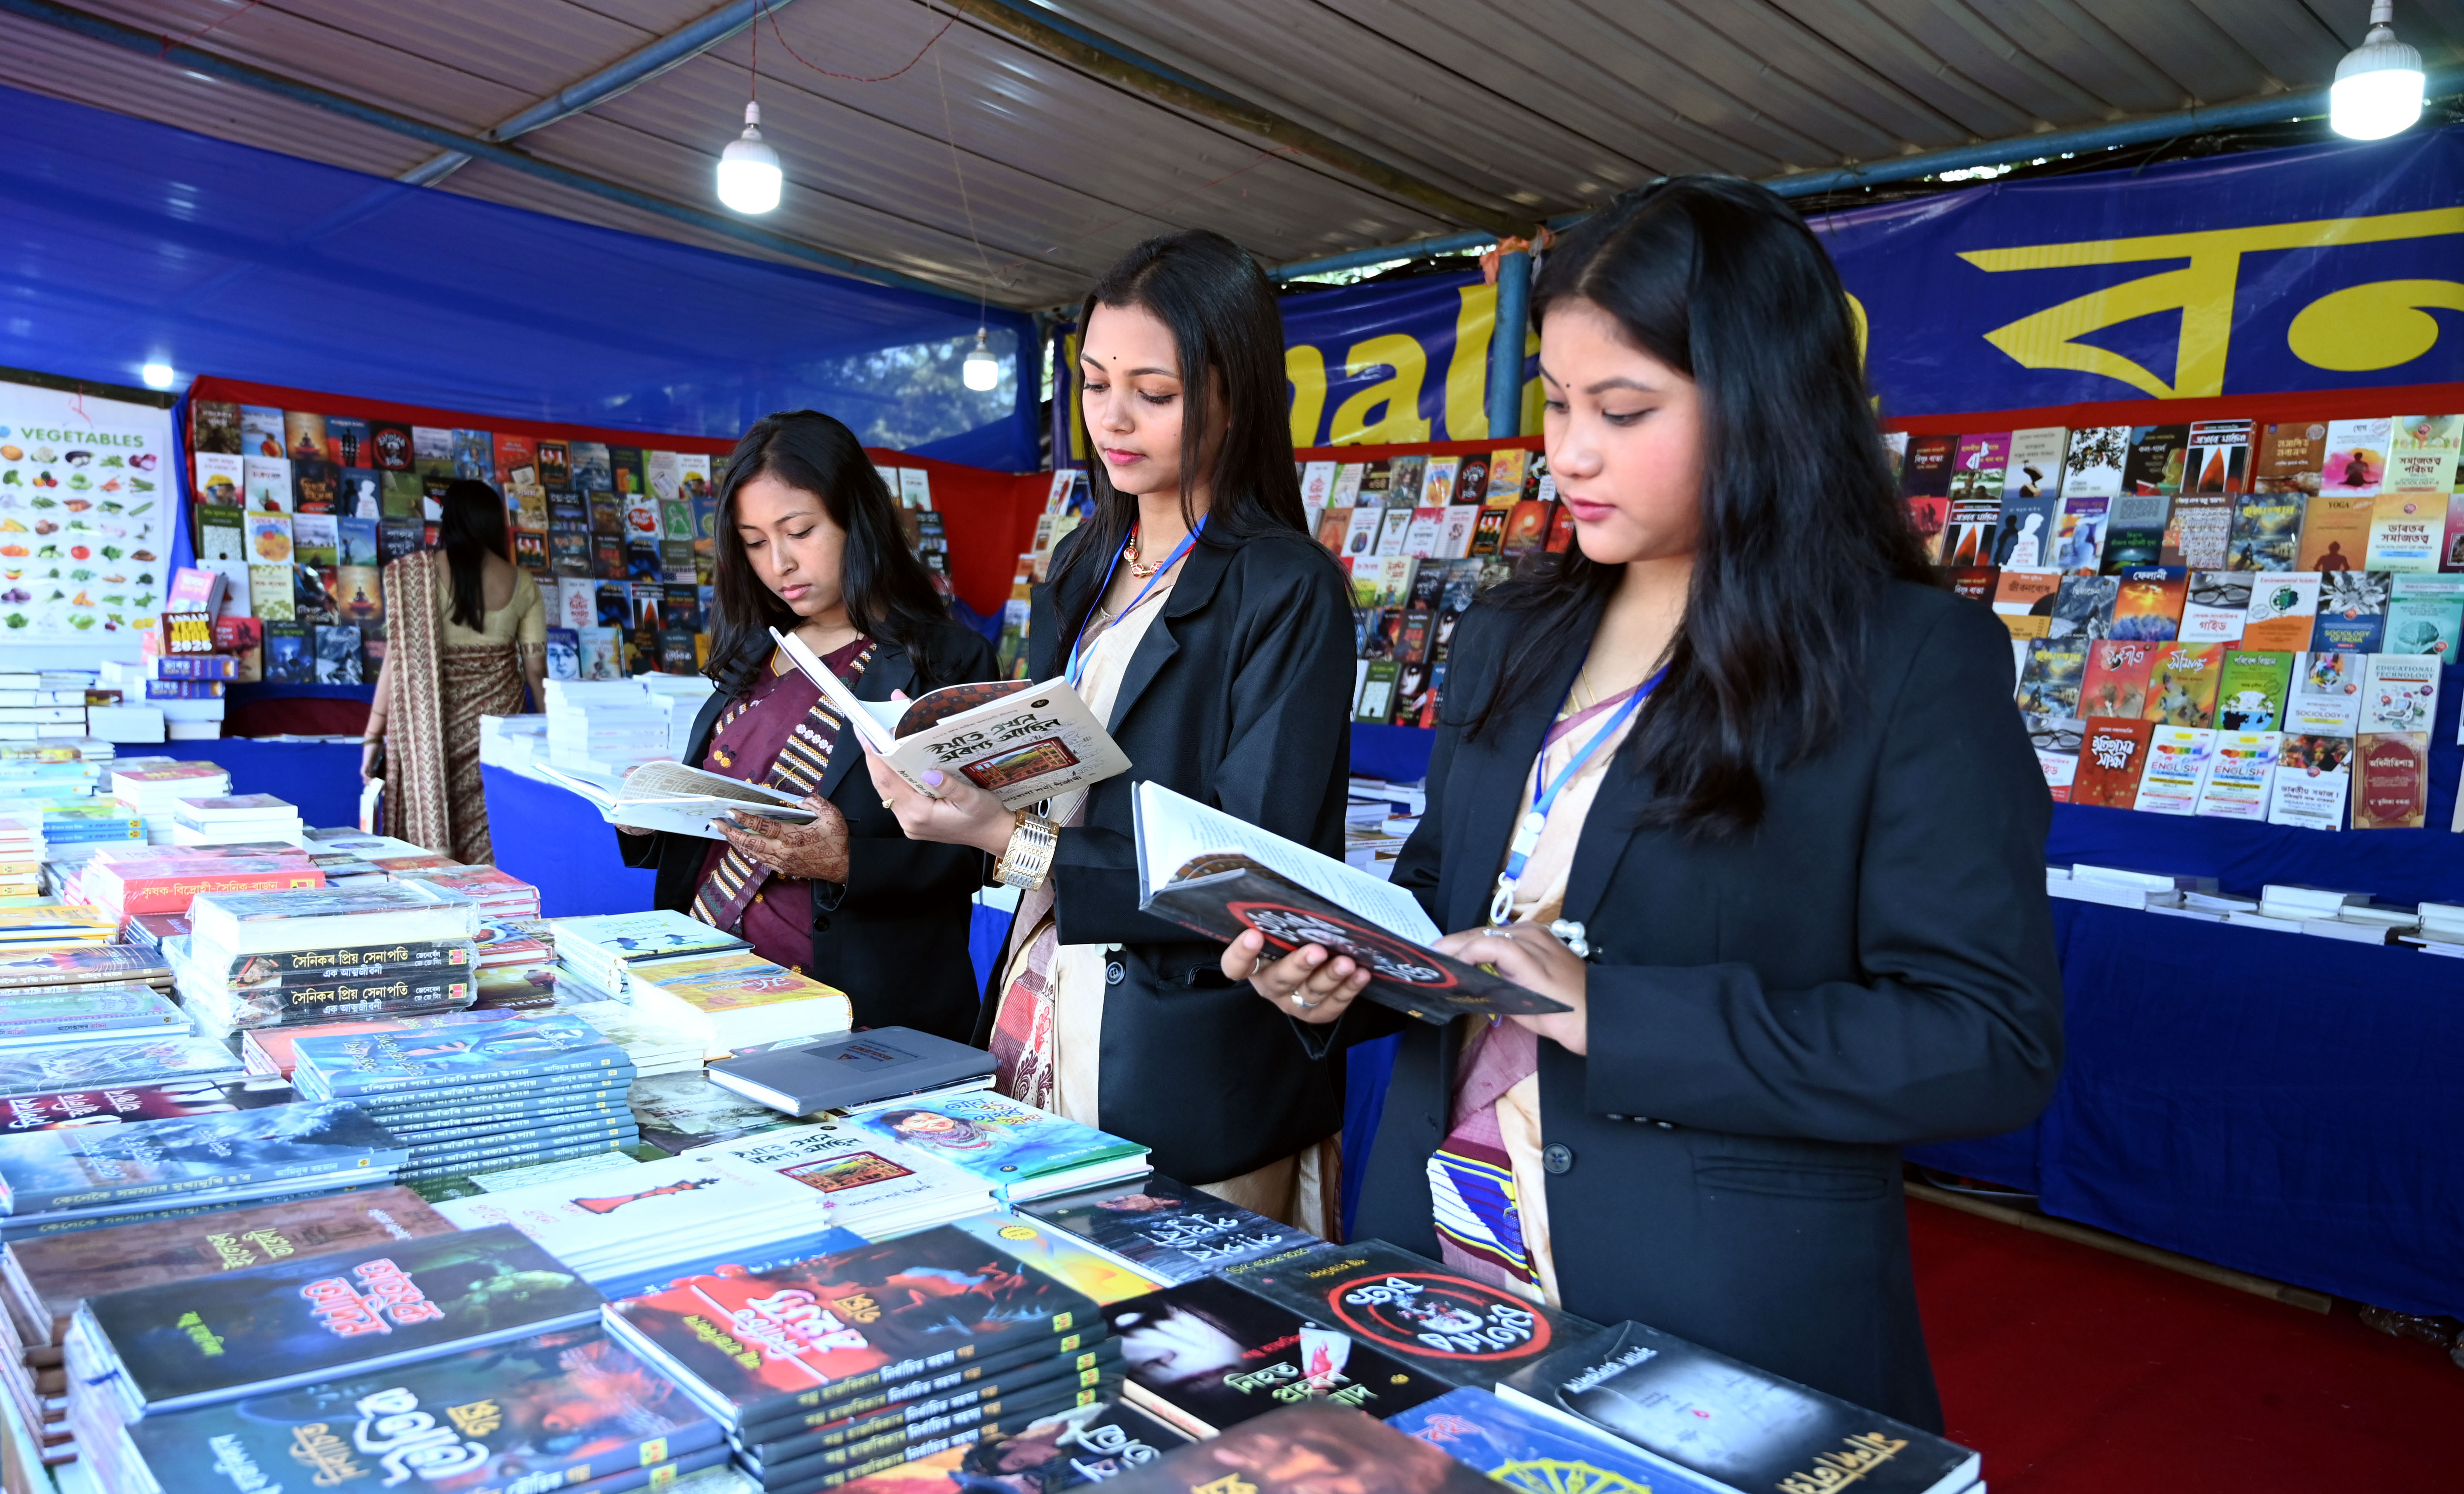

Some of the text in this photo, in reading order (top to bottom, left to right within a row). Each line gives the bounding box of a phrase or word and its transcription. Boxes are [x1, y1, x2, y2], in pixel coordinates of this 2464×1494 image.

[21, 427, 144, 448] VEGETABLES
[2388, 524, 2425, 533] ভাৰতৰ
[2133, 570, 2167, 581] ফেলানী
[2200, 620, 2227, 632] গাইড
[171, 641, 212, 652] 2026
[923, 713, 1038, 754] ইয়াত এখন
[938, 718, 1061, 763] অৰণ্য আছিল
[2092, 735, 2135, 755] ইতিহাসৰ
[2096, 752, 2127, 769] সাক্ষী
[2152, 762, 2199, 772] ENGLISH
[2214, 765, 2265, 776] ENGLISH
[2281, 785, 2310, 795] ভাৰতীয়
[292, 946, 408, 969] সৈনিকৰ প্ৰিয় সেনাপতি
[323, 969, 338, 978] এক
[291, 981, 408, 1005] সৈনিকৰ প্ৰিয় সেনাপতি
[432, 992, 441, 1001] সিং
[323, 1005, 338, 1014] এক
[9, 1097, 48, 1130] সিপাৰৰ
[103, 1088, 141, 1114] আন্ধাৰ
[945, 1098, 986, 1111] মৌন
[962, 1108, 1025, 1121] মুখৰ
[1001, 1114, 1043, 1126] হৃদয়
[791, 1134, 834, 1147] এখন
[803, 1138, 864, 1153] আছিল
[52, 1191, 111, 1206] কেনেকৈ
[275, 1168, 307, 1178] আমিনুৰ
[310, 1162, 338, 1173] ৰহমান
[243, 1228, 294, 1259] ডায়েৰী
[1135, 1213, 1239, 1251] পুখুৰী
[1181, 1233, 1282, 1262] পাপৰ
[354, 1258, 445, 1324] আতংক
[1346, 1277, 1425, 1306] চক্ৰ
[300, 1277, 392, 1338] আদিম
[832, 1293, 881, 1323] গল্প
[746, 1289, 868, 1354] ৰহস্য
[1418, 1304, 1534, 1352] চয়তানৰ
[732, 1309, 811, 1360] নিৰ্বাচিত
[1222, 1361, 1299, 1394] নিহত
[1272, 1369, 1352, 1403] প্ৰহৰৰ
[447, 1399, 502, 1437] গল্প
[354, 1388, 489, 1487] ভৌতিক
[289, 1422, 371, 1486] নিৰ্বাচিত
